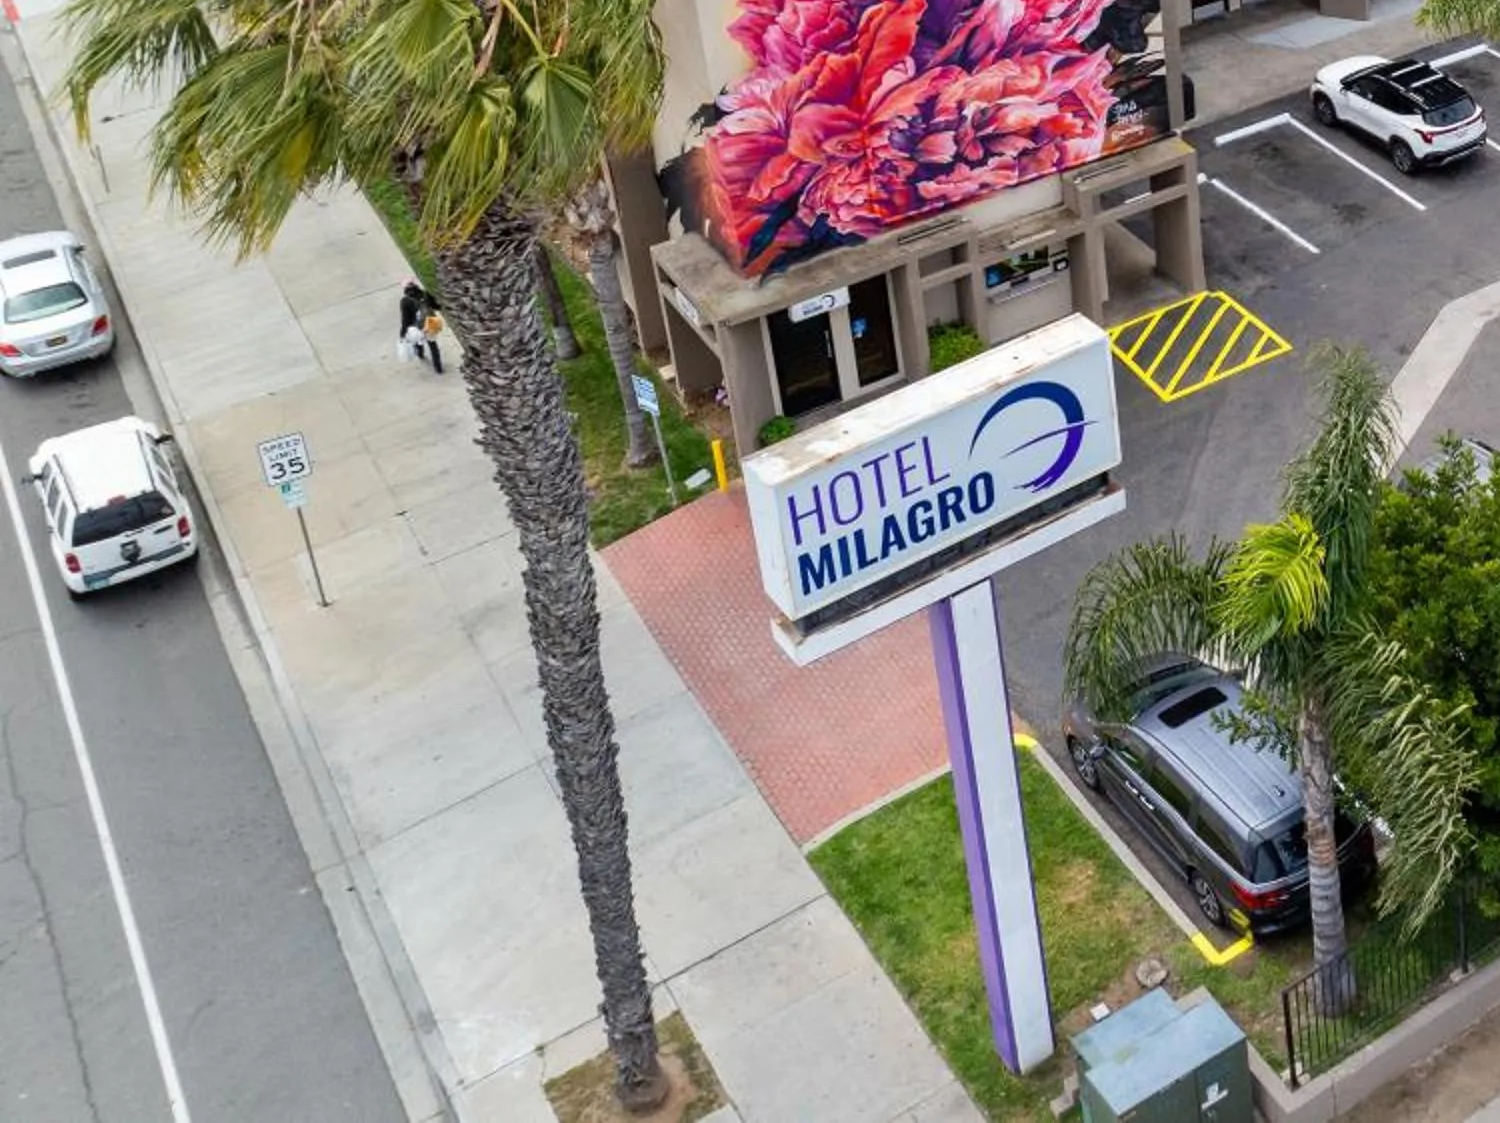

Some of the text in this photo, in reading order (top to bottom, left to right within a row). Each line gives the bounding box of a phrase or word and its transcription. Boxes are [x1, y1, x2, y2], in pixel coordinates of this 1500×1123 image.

[263, 438, 301, 455] SPEED
[268, 448, 297, 462] LIMIT
[270, 456, 305, 480] 35
[787, 436, 950, 546] HOTEL
[798, 471, 995, 595] MILAGRO
